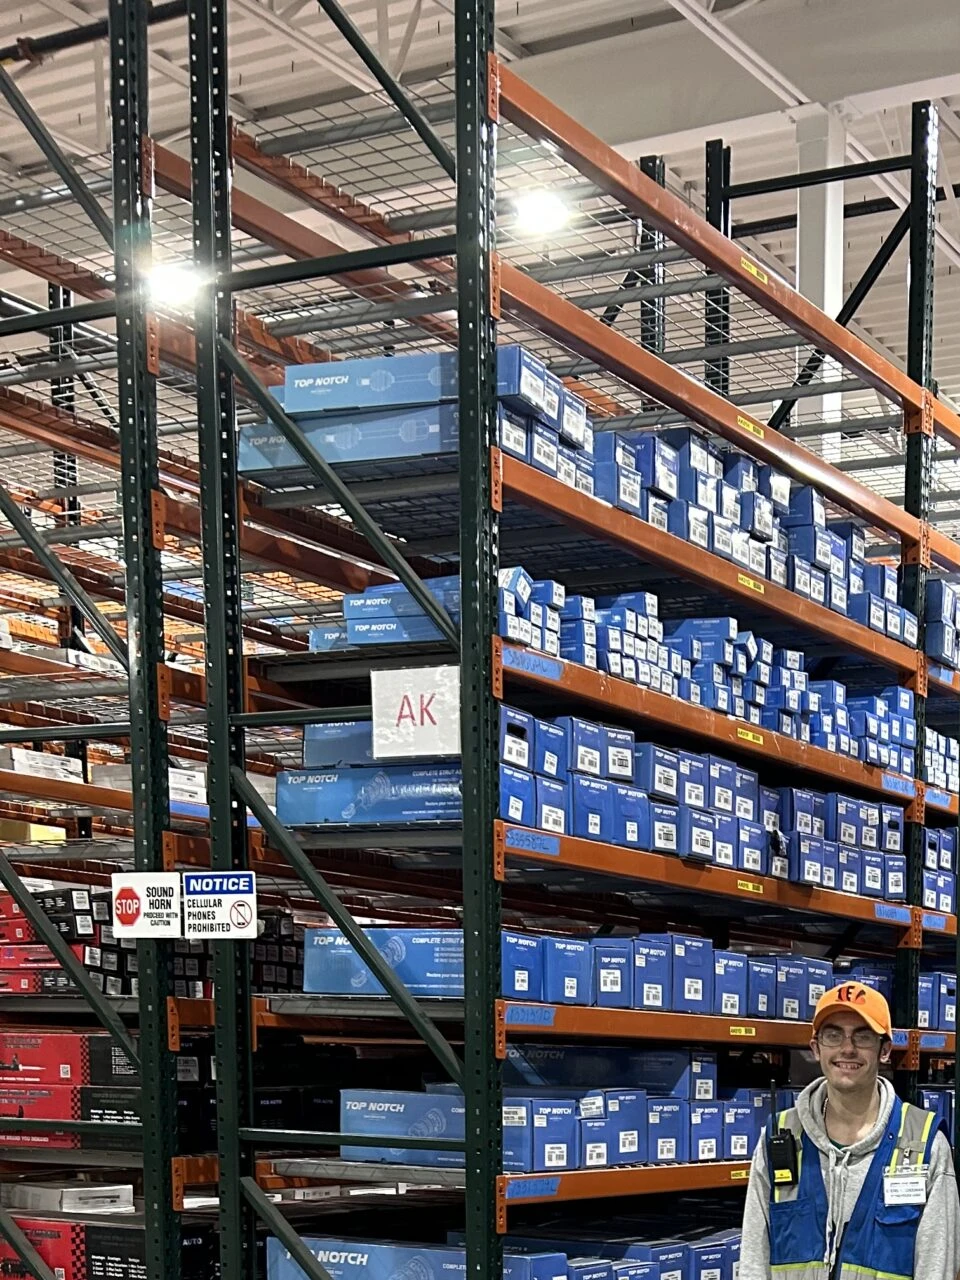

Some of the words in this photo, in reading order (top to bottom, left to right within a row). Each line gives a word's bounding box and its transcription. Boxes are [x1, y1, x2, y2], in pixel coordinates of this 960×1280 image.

[294, 377, 313, 388] TOP
[315, 375, 349, 386] NOTCH
[370, 623, 397, 631] NOTCH
[324, 632, 339, 640] TOP
[396, 692, 437, 727] AK
[288, 776, 306, 784] TOP
[307, 774, 338, 784] NOTCH
[580, 779, 590, 787] TOP
[591, 782, 608, 791] NOTCH
[190, 878, 249, 891] NOTICE
[146, 886, 174, 898] SOUND
[116, 900, 140, 914] STOP
[149, 900, 172, 910] HORN
[187, 899, 222, 908] CELLULAR
[188, 911, 216, 920] PHONES
[188, 923, 231, 932] PROHIBITED
[313, 937, 334, 945] TOP
[506, 936, 518, 944] TOP
[519, 939, 537, 948] NOTCH
[555, 942, 566, 950] TOP
[566, 944, 584, 952] NOTCH
[639, 947, 649, 955] TOP
[650, 948, 666, 957] NOTCH
[727, 960, 743, 968] NOTCH
[346, 1101, 366, 1111] TOP
[368, 1102, 404, 1112] NOTCH
[318, 1250, 368, 1266] NOTCH
[670, 1252, 683, 1260] NOTCH
[594, 1272, 608, 1280] NOTCH
